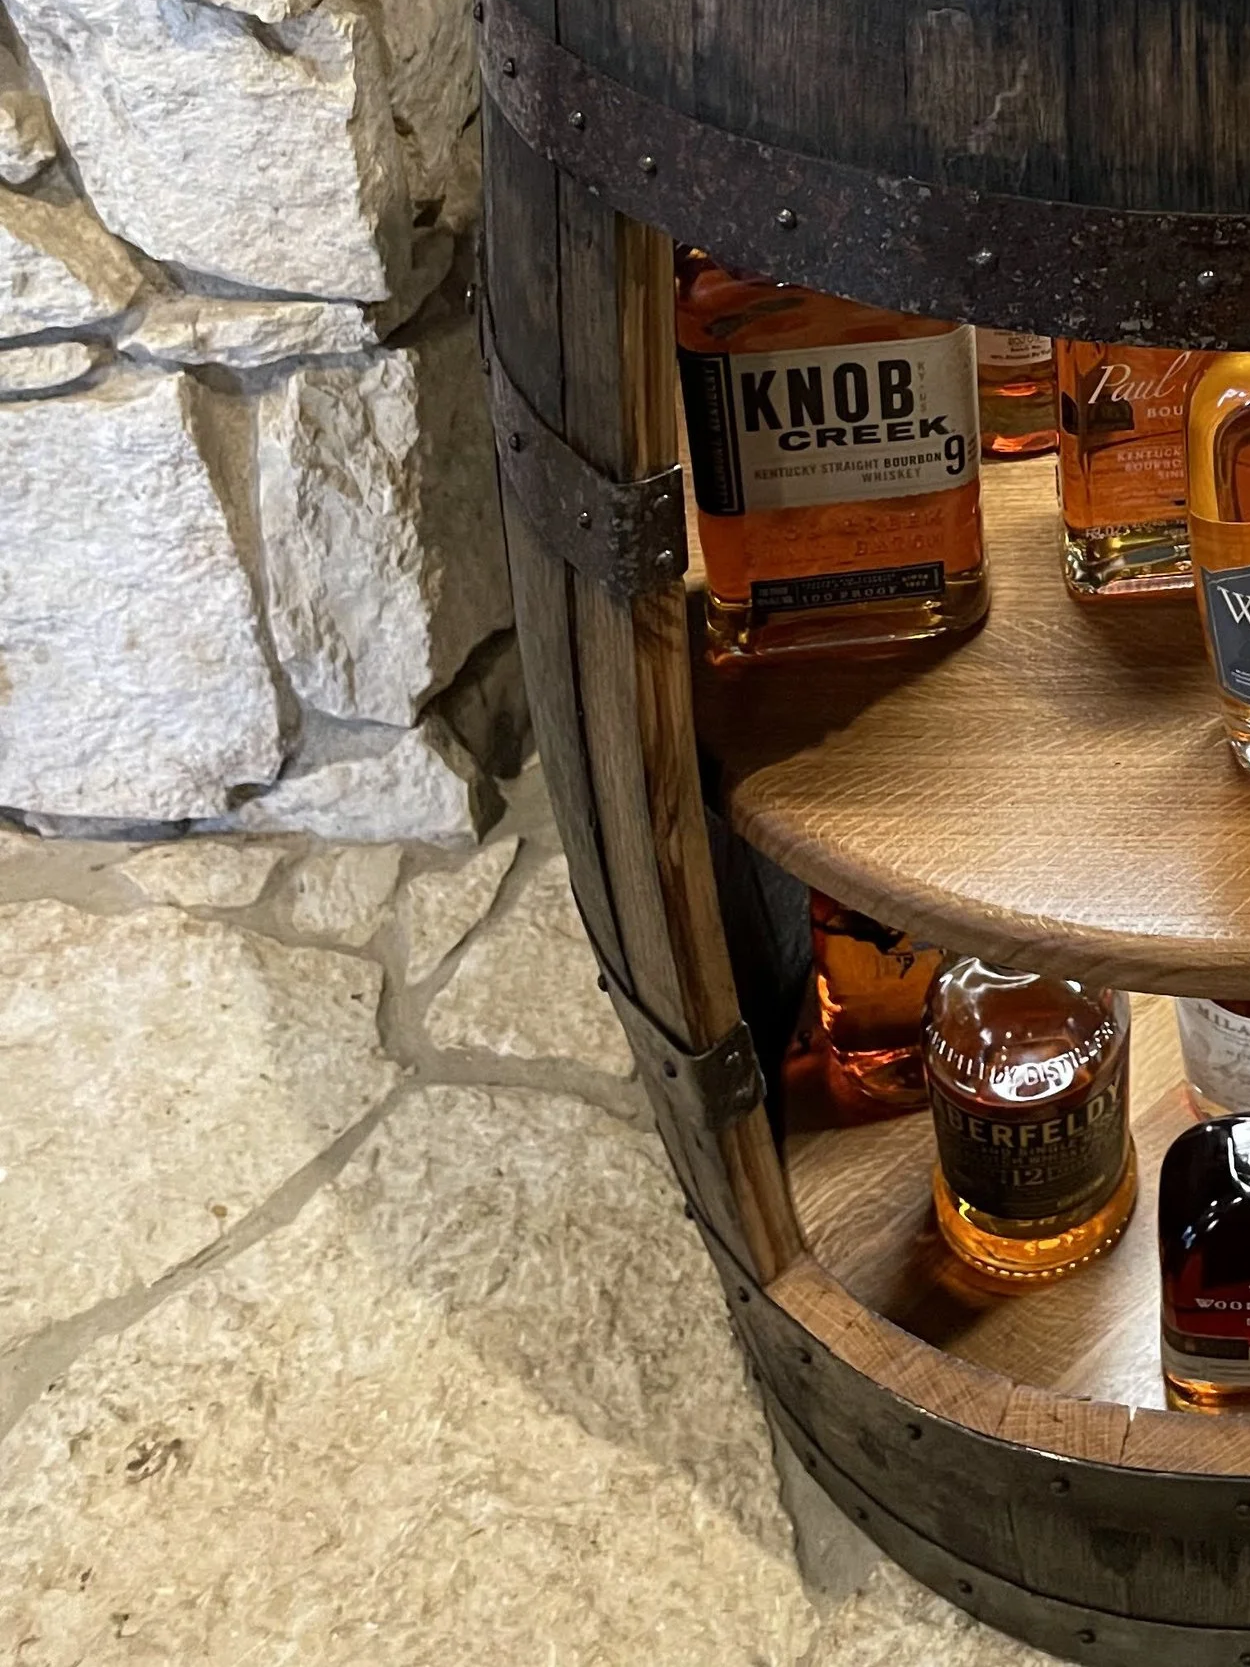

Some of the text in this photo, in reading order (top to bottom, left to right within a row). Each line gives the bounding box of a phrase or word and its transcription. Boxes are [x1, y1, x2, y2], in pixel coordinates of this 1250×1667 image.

[1088, 351, 1191, 405] Paul
[740, 359, 915, 433] KNOB
[1146, 405, 1184, 419] BOU
[778, 415, 951, 451] CREEK
[754, 452, 942, 481] KENTUCKY STRAIGHT BOURBON
[944, 434, 965, 475] 9
[1117, 446, 1182, 462] KENTUCK
[1125, 459, 1183, 472] BOURBO
[861, 468, 922, 484] WHISKEY
